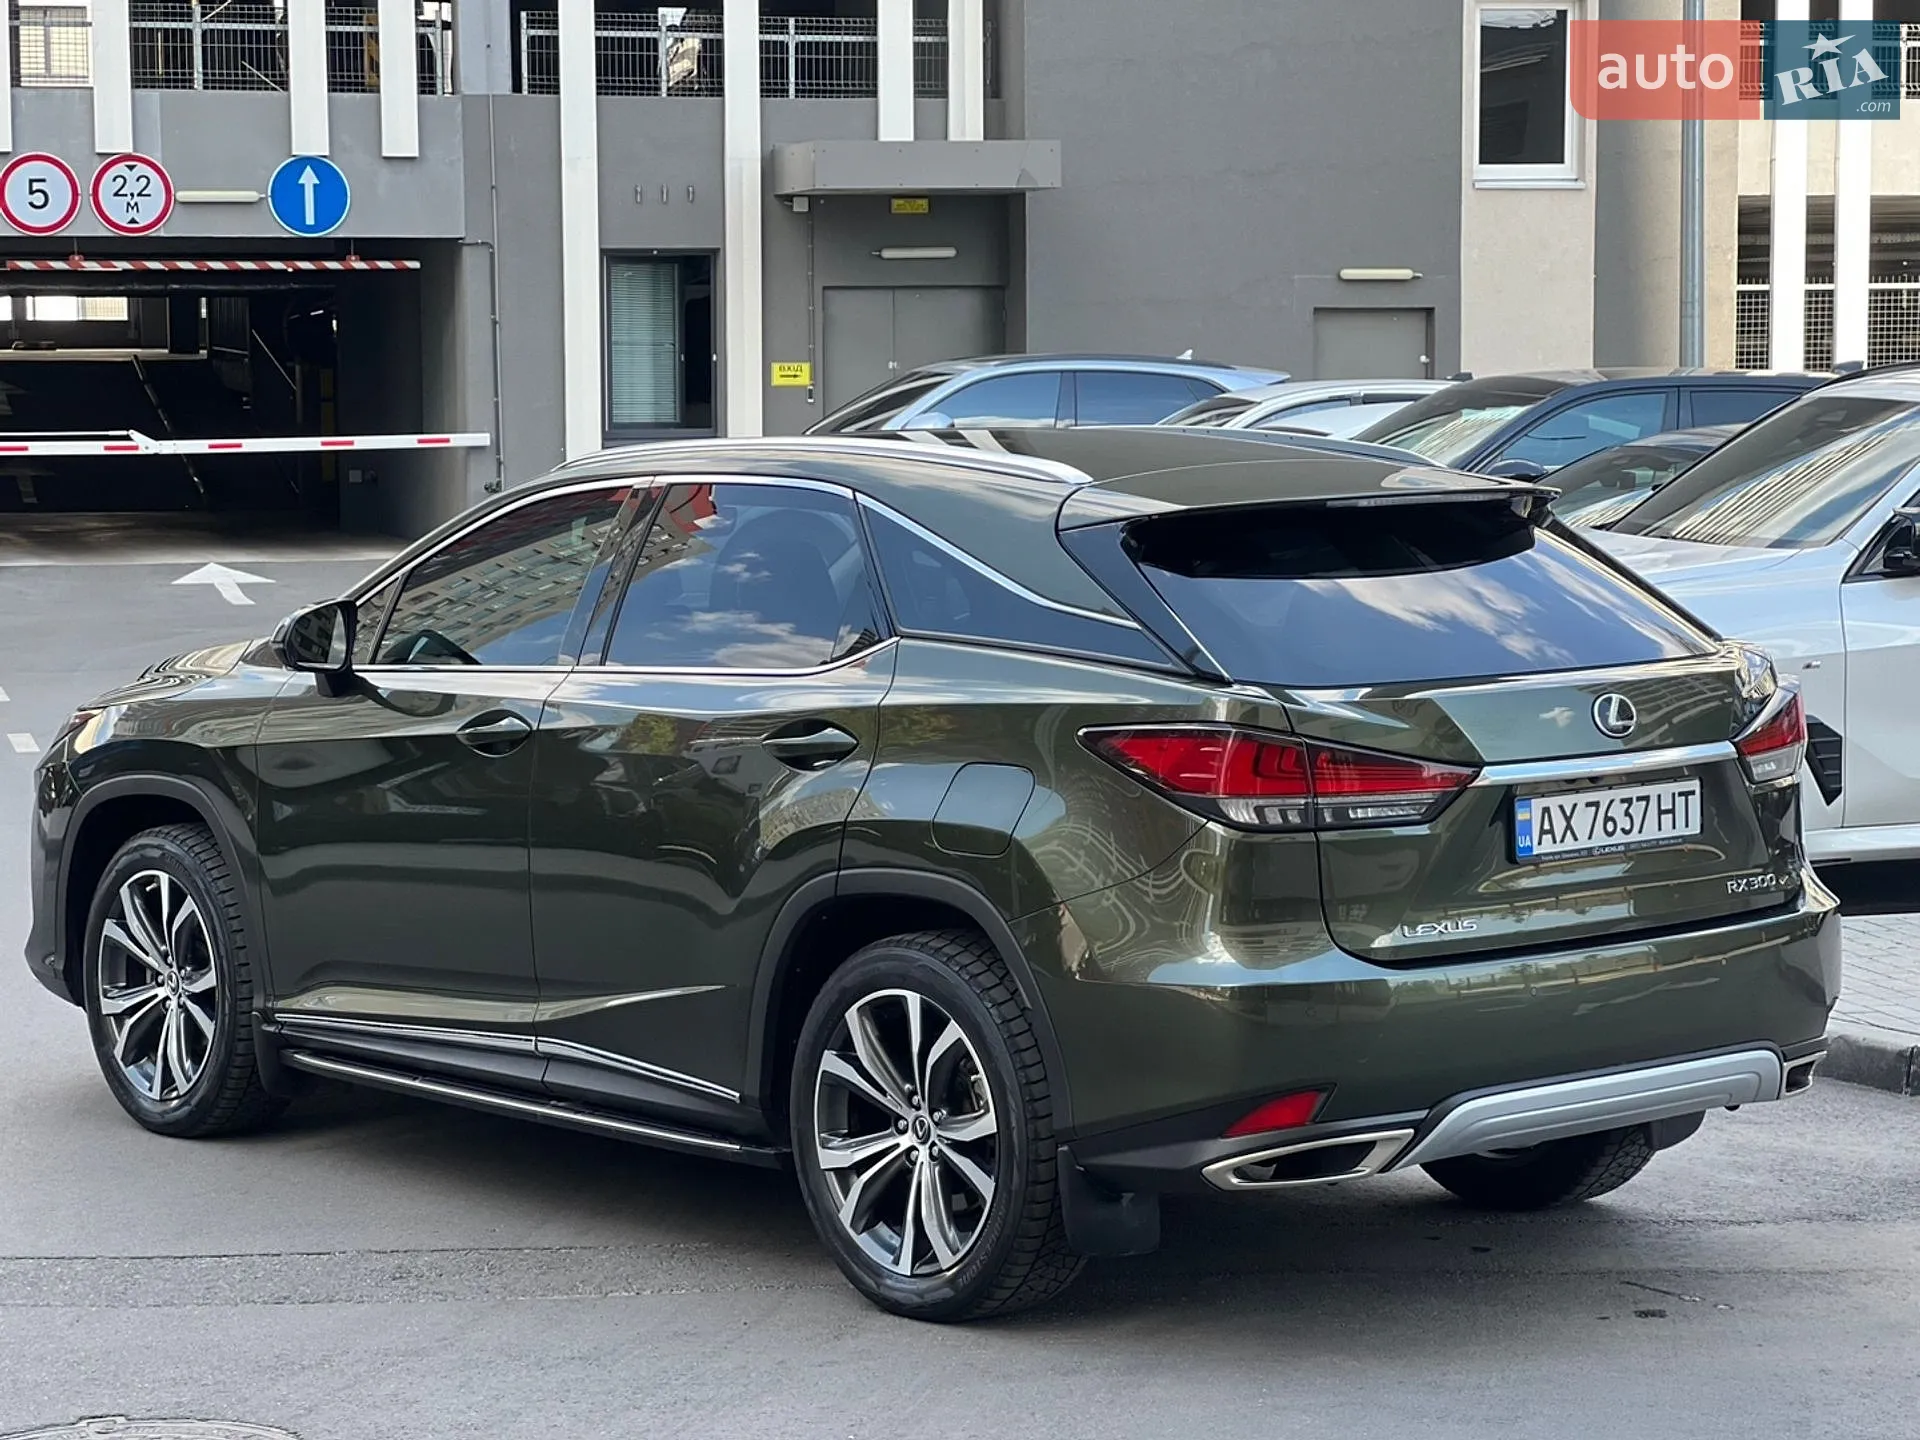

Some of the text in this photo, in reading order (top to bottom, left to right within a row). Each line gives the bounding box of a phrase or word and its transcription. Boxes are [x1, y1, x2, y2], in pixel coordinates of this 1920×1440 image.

[28, 178, 50, 210] 5
[112, 174, 151, 200] 2,2
[1537, 790, 1696, 846] AX 7637 HT
[1518, 837, 1532, 848] UA
[1402, 918, 1478, 938] LEXUS
